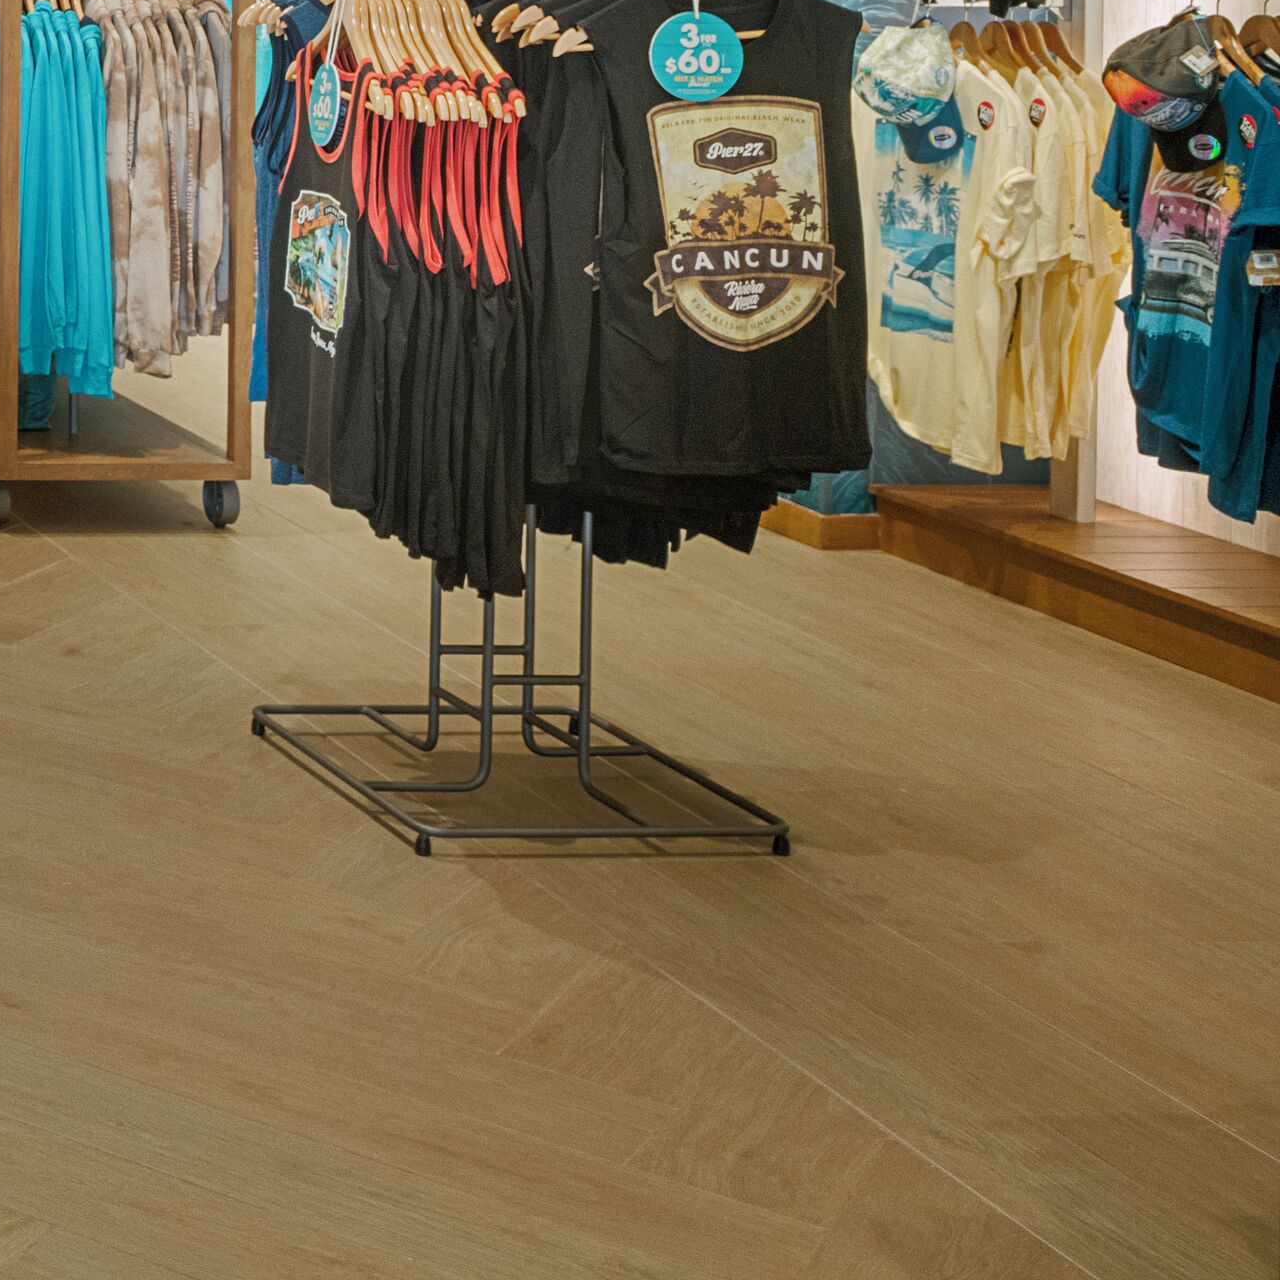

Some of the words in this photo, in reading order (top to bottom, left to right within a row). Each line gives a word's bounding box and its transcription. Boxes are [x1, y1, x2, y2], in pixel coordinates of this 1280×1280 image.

[680, 23, 699, 48] 3
[701, 34, 717, 43] FOR
[665, 48, 720, 74] $60
[671, 248, 823, 273] CANCUN
